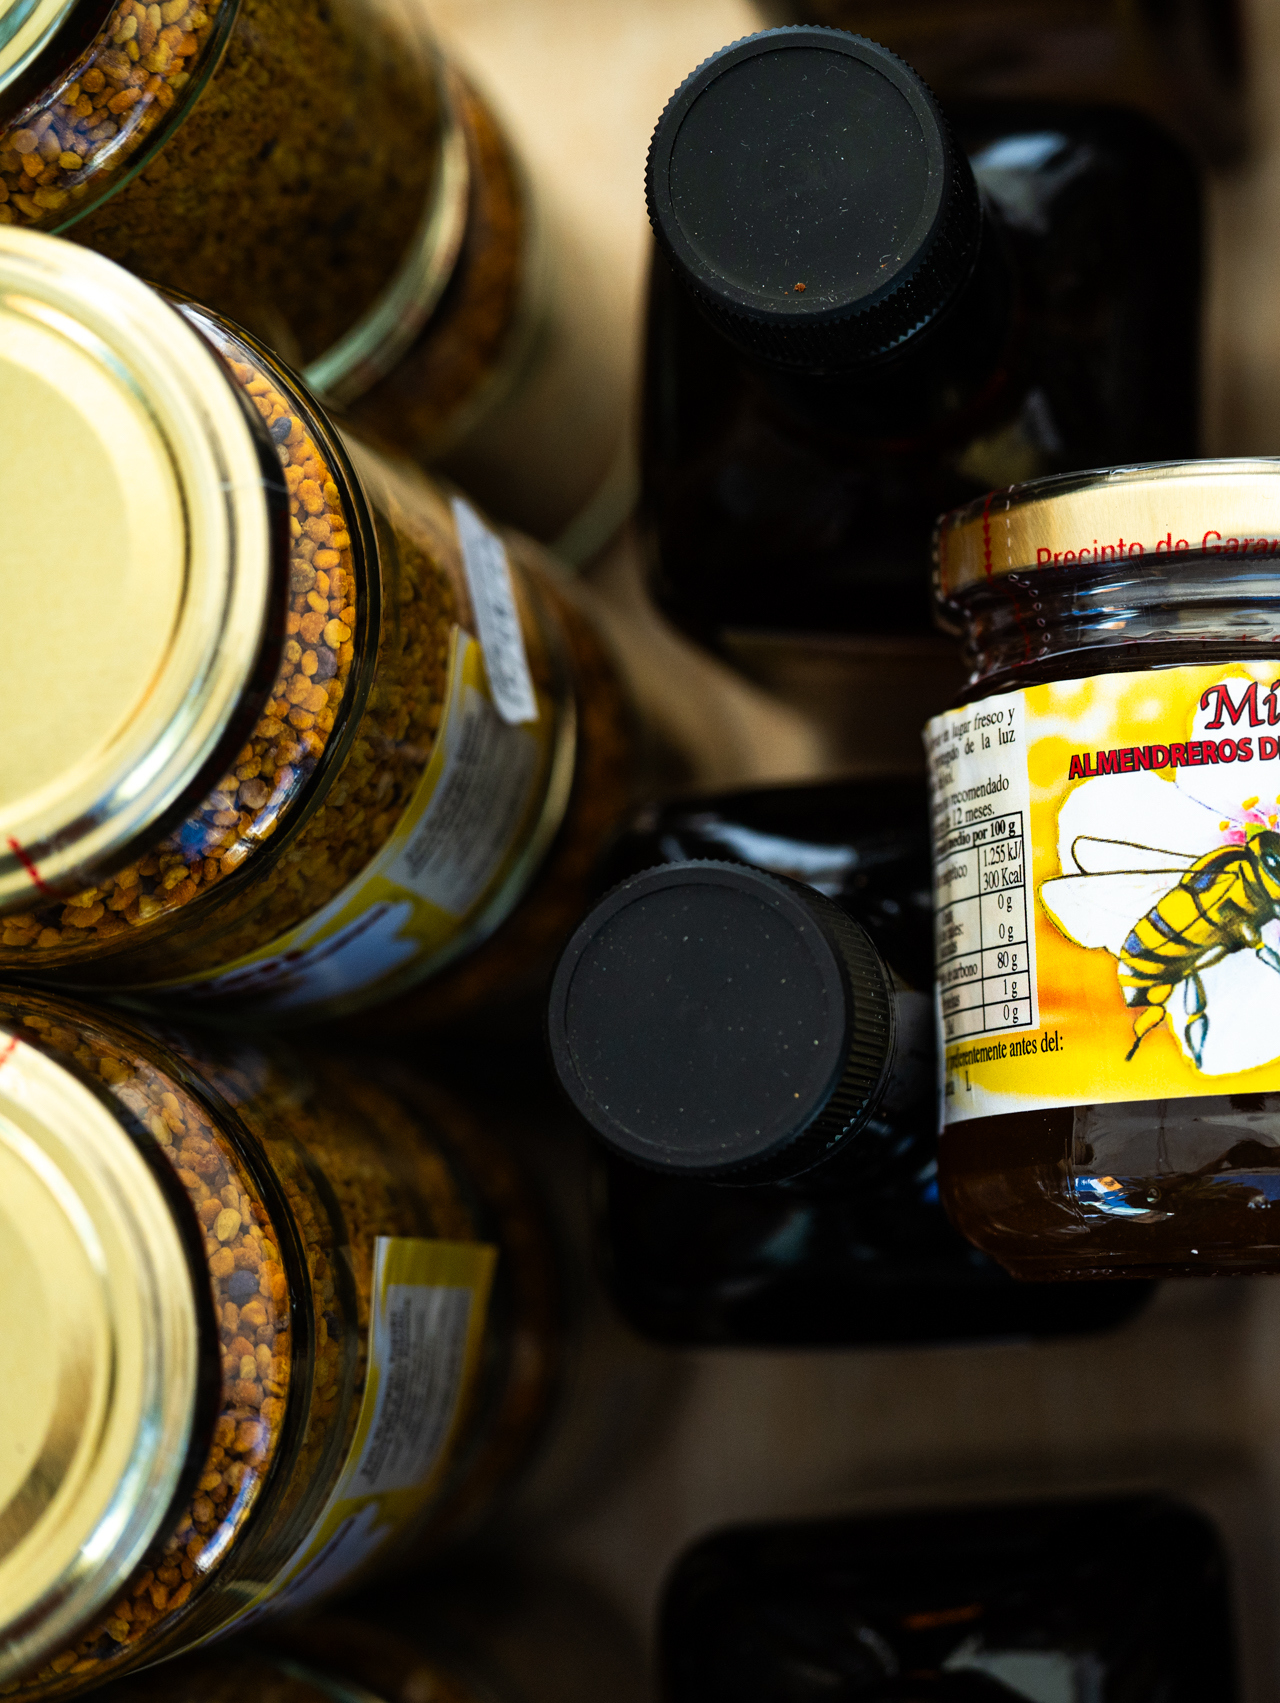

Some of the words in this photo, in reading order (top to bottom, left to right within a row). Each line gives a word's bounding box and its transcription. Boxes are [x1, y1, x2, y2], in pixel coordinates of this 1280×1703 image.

[1036, 537, 1144, 573] Precinto
[1155, 532, 1190, 558] de
[974, 712, 1004, 731] fresco
[1007, 707, 1015, 726] y
[964, 736, 975, 755] de
[981, 733, 990, 750] la
[998, 727, 1016, 746] luz
[1068, 738, 1253, 780] ALMENDREROS
[965, 803, 995, 823] meses.
[973, 828, 988, 847] por
[990, 819, 1006, 838] 100
[1008, 821, 1016, 838] g
[984, 844, 1006, 867] 1.255
[1007, 840, 1022, 862] kJ/
[983, 870, 1000, 891] 300
[1001, 864, 1023, 887] Kcal
[998, 893, 1005, 910] 0
[1007, 896, 1013, 913] g
[999, 923, 1006, 939] 0
[1008, 926, 1014, 942] g
[997, 951, 1009, 969] 80
[1011, 953, 1018, 971] g
[1003, 979, 1008, 995] 1
[1011, 981, 1018, 998] g
[1003, 1004, 1010, 1021] 0
[1012, 1007, 1019, 1024] g
[1009, 1037, 1037, 1058] antes
[1041, 1030, 1064, 1052] del:
